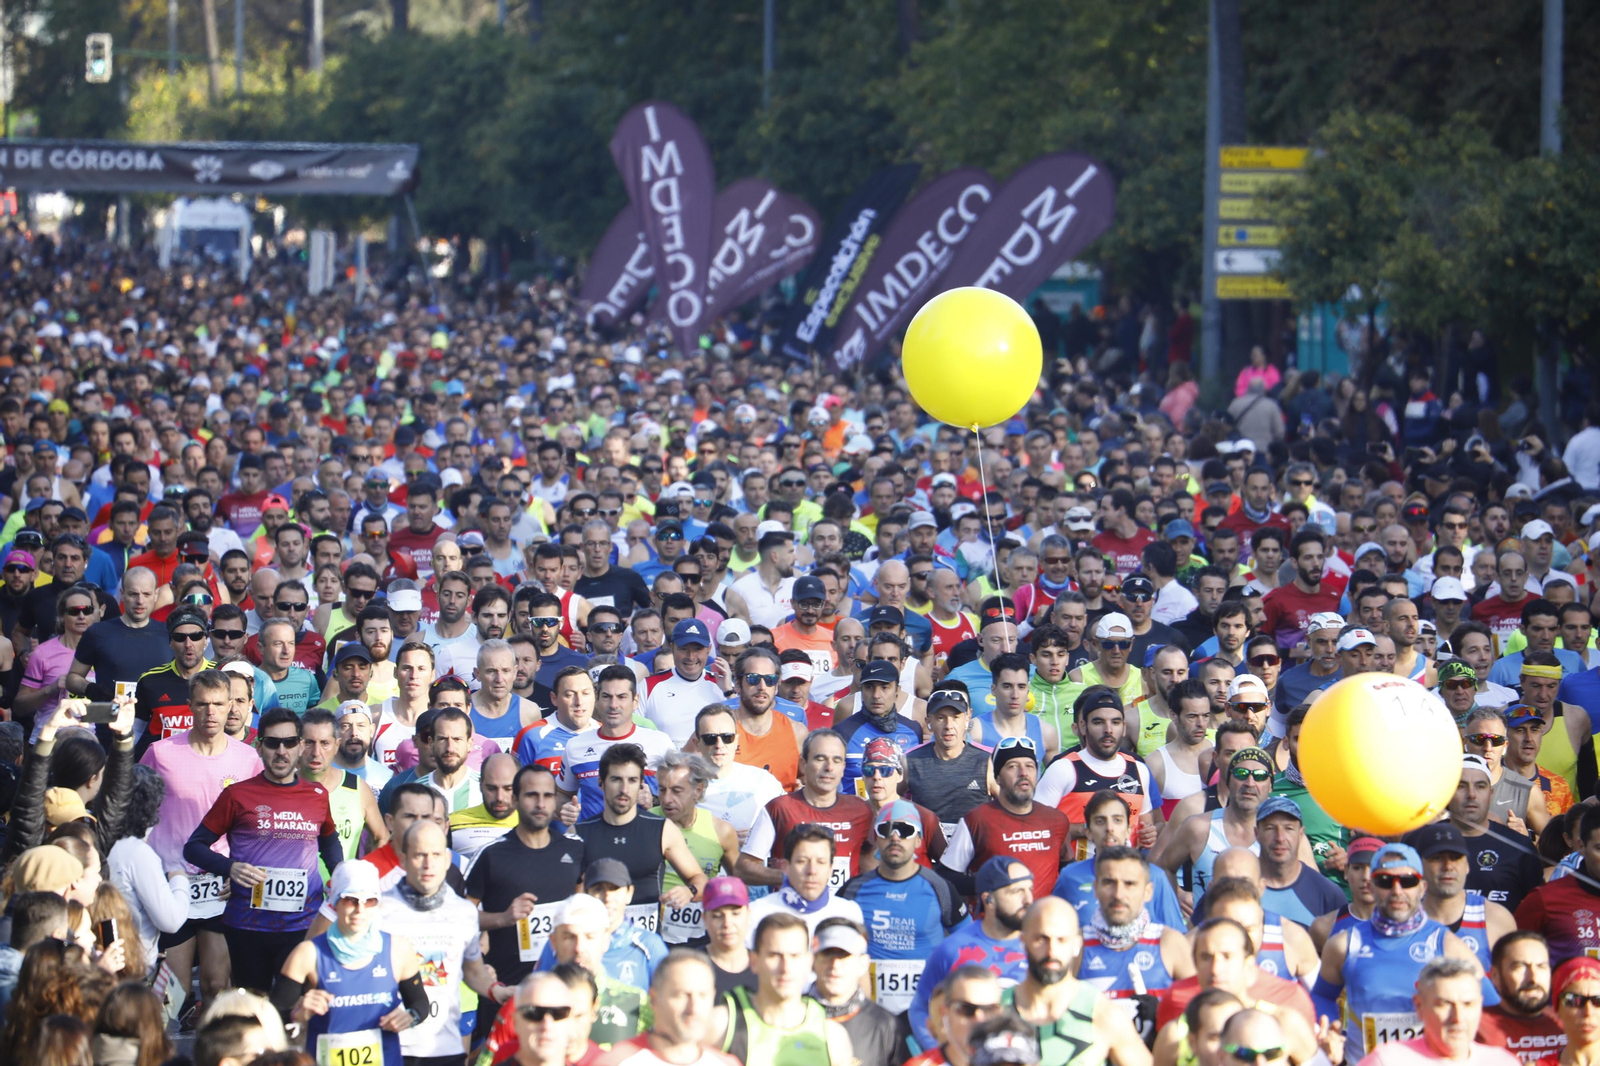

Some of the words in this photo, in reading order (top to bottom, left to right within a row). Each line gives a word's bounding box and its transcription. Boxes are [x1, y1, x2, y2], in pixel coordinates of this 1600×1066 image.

[14, 149, 43, 169] DE
[50, 146, 164, 171] CÓRDOBA
[973, 163, 1098, 287] IMDE
[273, 811, 303, 821] MEDIA
[257, 819, 271, 829] 36
[274, 820, 318, 832] MARATÓN
[1002, 829, 1051, 842] LOBOS
[1008, 842, 1051, 852] TRAIL
[190, 881, 220, 900] 373
[265, 879, 305, 898] 1032
[670, 907, 702, 925] 860
[871, 909, 891, 930] 5
[890, 917, 916, 927] TRAIL
[872, 930, 916, 941] MONTES
[1577, 926, 1595, 939] 36
[877, 973, 922, 991] 1515
[1506, 1034, 1568, 1048] LOBOS
[337, 1046, 373, 1066] 102
